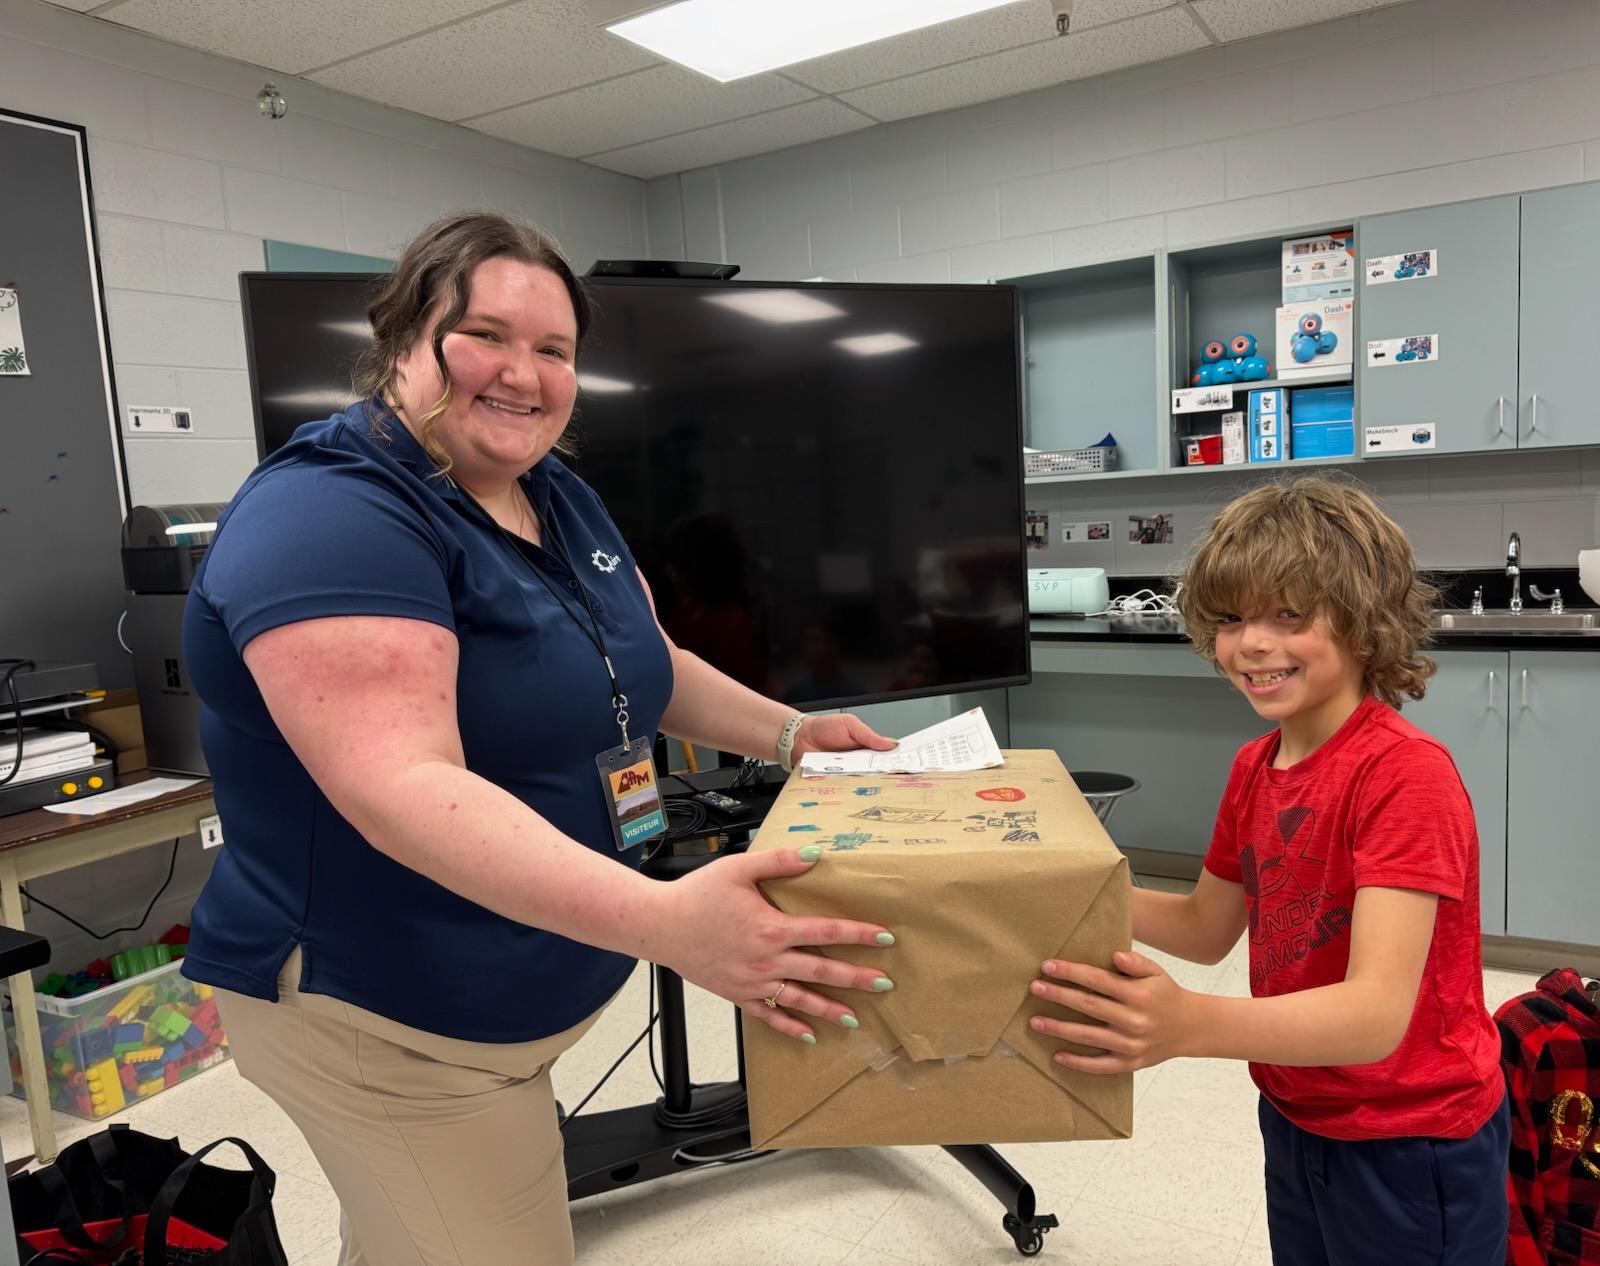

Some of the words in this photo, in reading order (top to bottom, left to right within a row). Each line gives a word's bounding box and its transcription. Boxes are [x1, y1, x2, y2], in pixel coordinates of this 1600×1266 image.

[1324, 305, 1344, 313] Dash
[1367, 427, 1398, 435] Makeblock
[624, 818, 660, 839] VISITEUR
